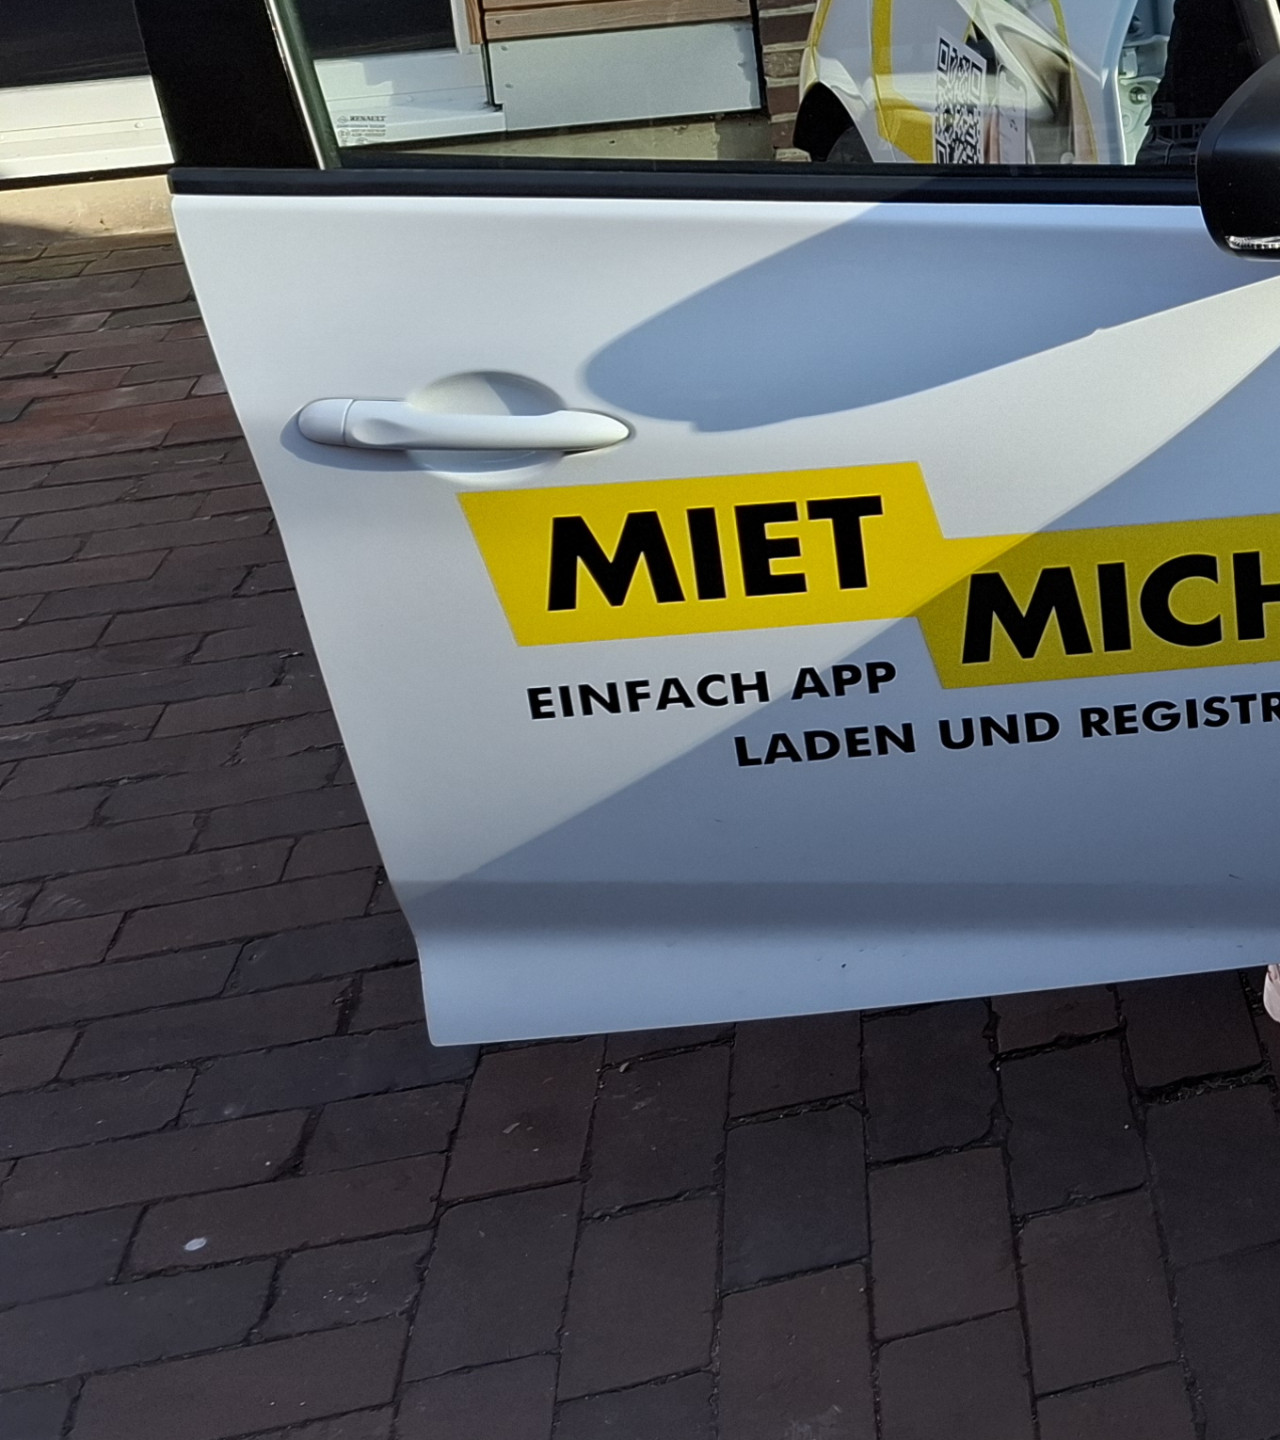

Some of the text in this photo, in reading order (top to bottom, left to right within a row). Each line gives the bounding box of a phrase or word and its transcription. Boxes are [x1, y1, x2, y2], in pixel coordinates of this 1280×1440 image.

[548, 495, 884, 612] MIET
[526, 661, 897, 720] EINFACH APP
[733, 722, 917, 767] LADEN
[938, 710, 1061, 750] UND
